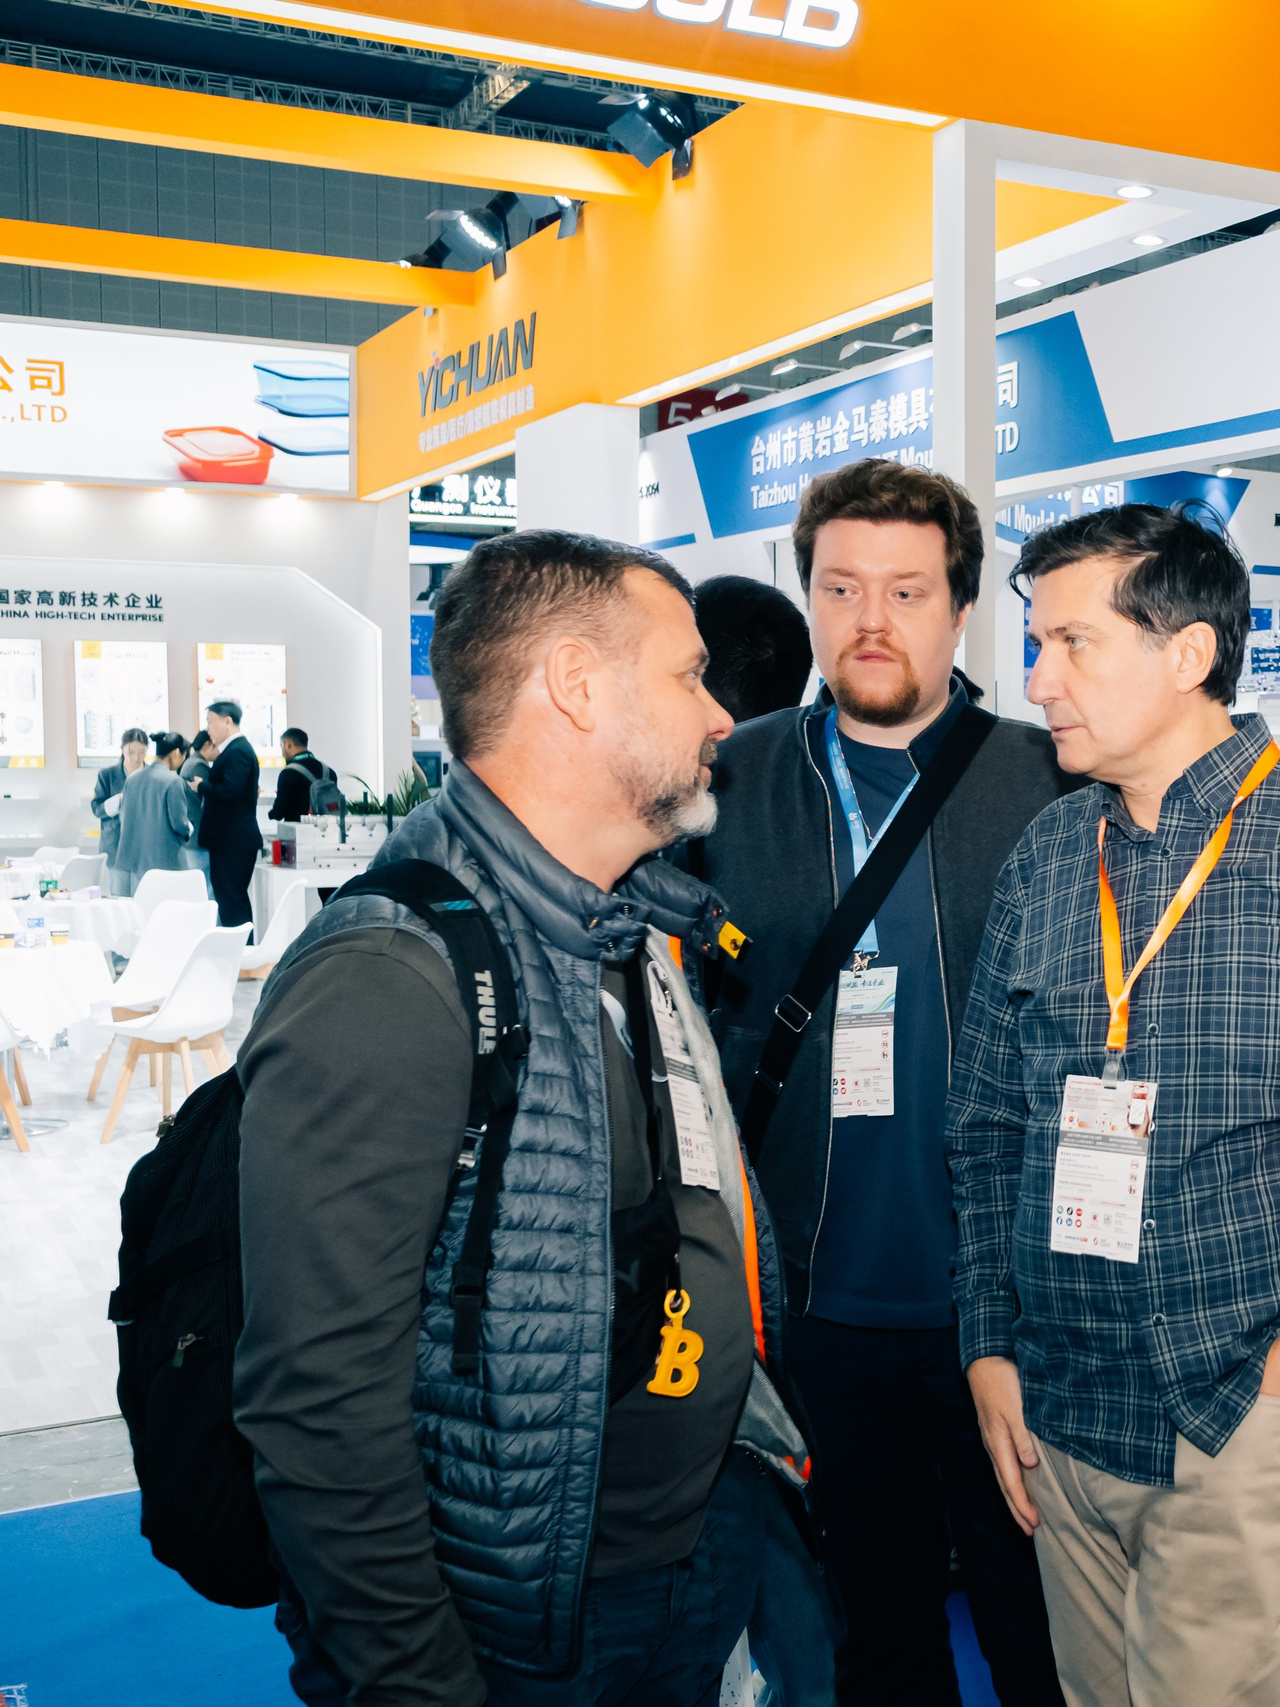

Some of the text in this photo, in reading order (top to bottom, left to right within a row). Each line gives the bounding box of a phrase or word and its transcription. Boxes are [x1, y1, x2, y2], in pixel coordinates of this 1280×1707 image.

[418, 311, 537, 418] YICHUAN
[751, 387, 933, 476] 台州市黄岩金马泰模具
[751, 481, 797, 510] Taizhou
[900, 446, 933, 469] Mou
[995, 421, 1019, 454] TD
[411, 474, 517, 506] 测仪
[0, 610, 164, 623] HINA HIGH-TECH ENTERPRISE
[474, 970, 497, 1054] THULE
